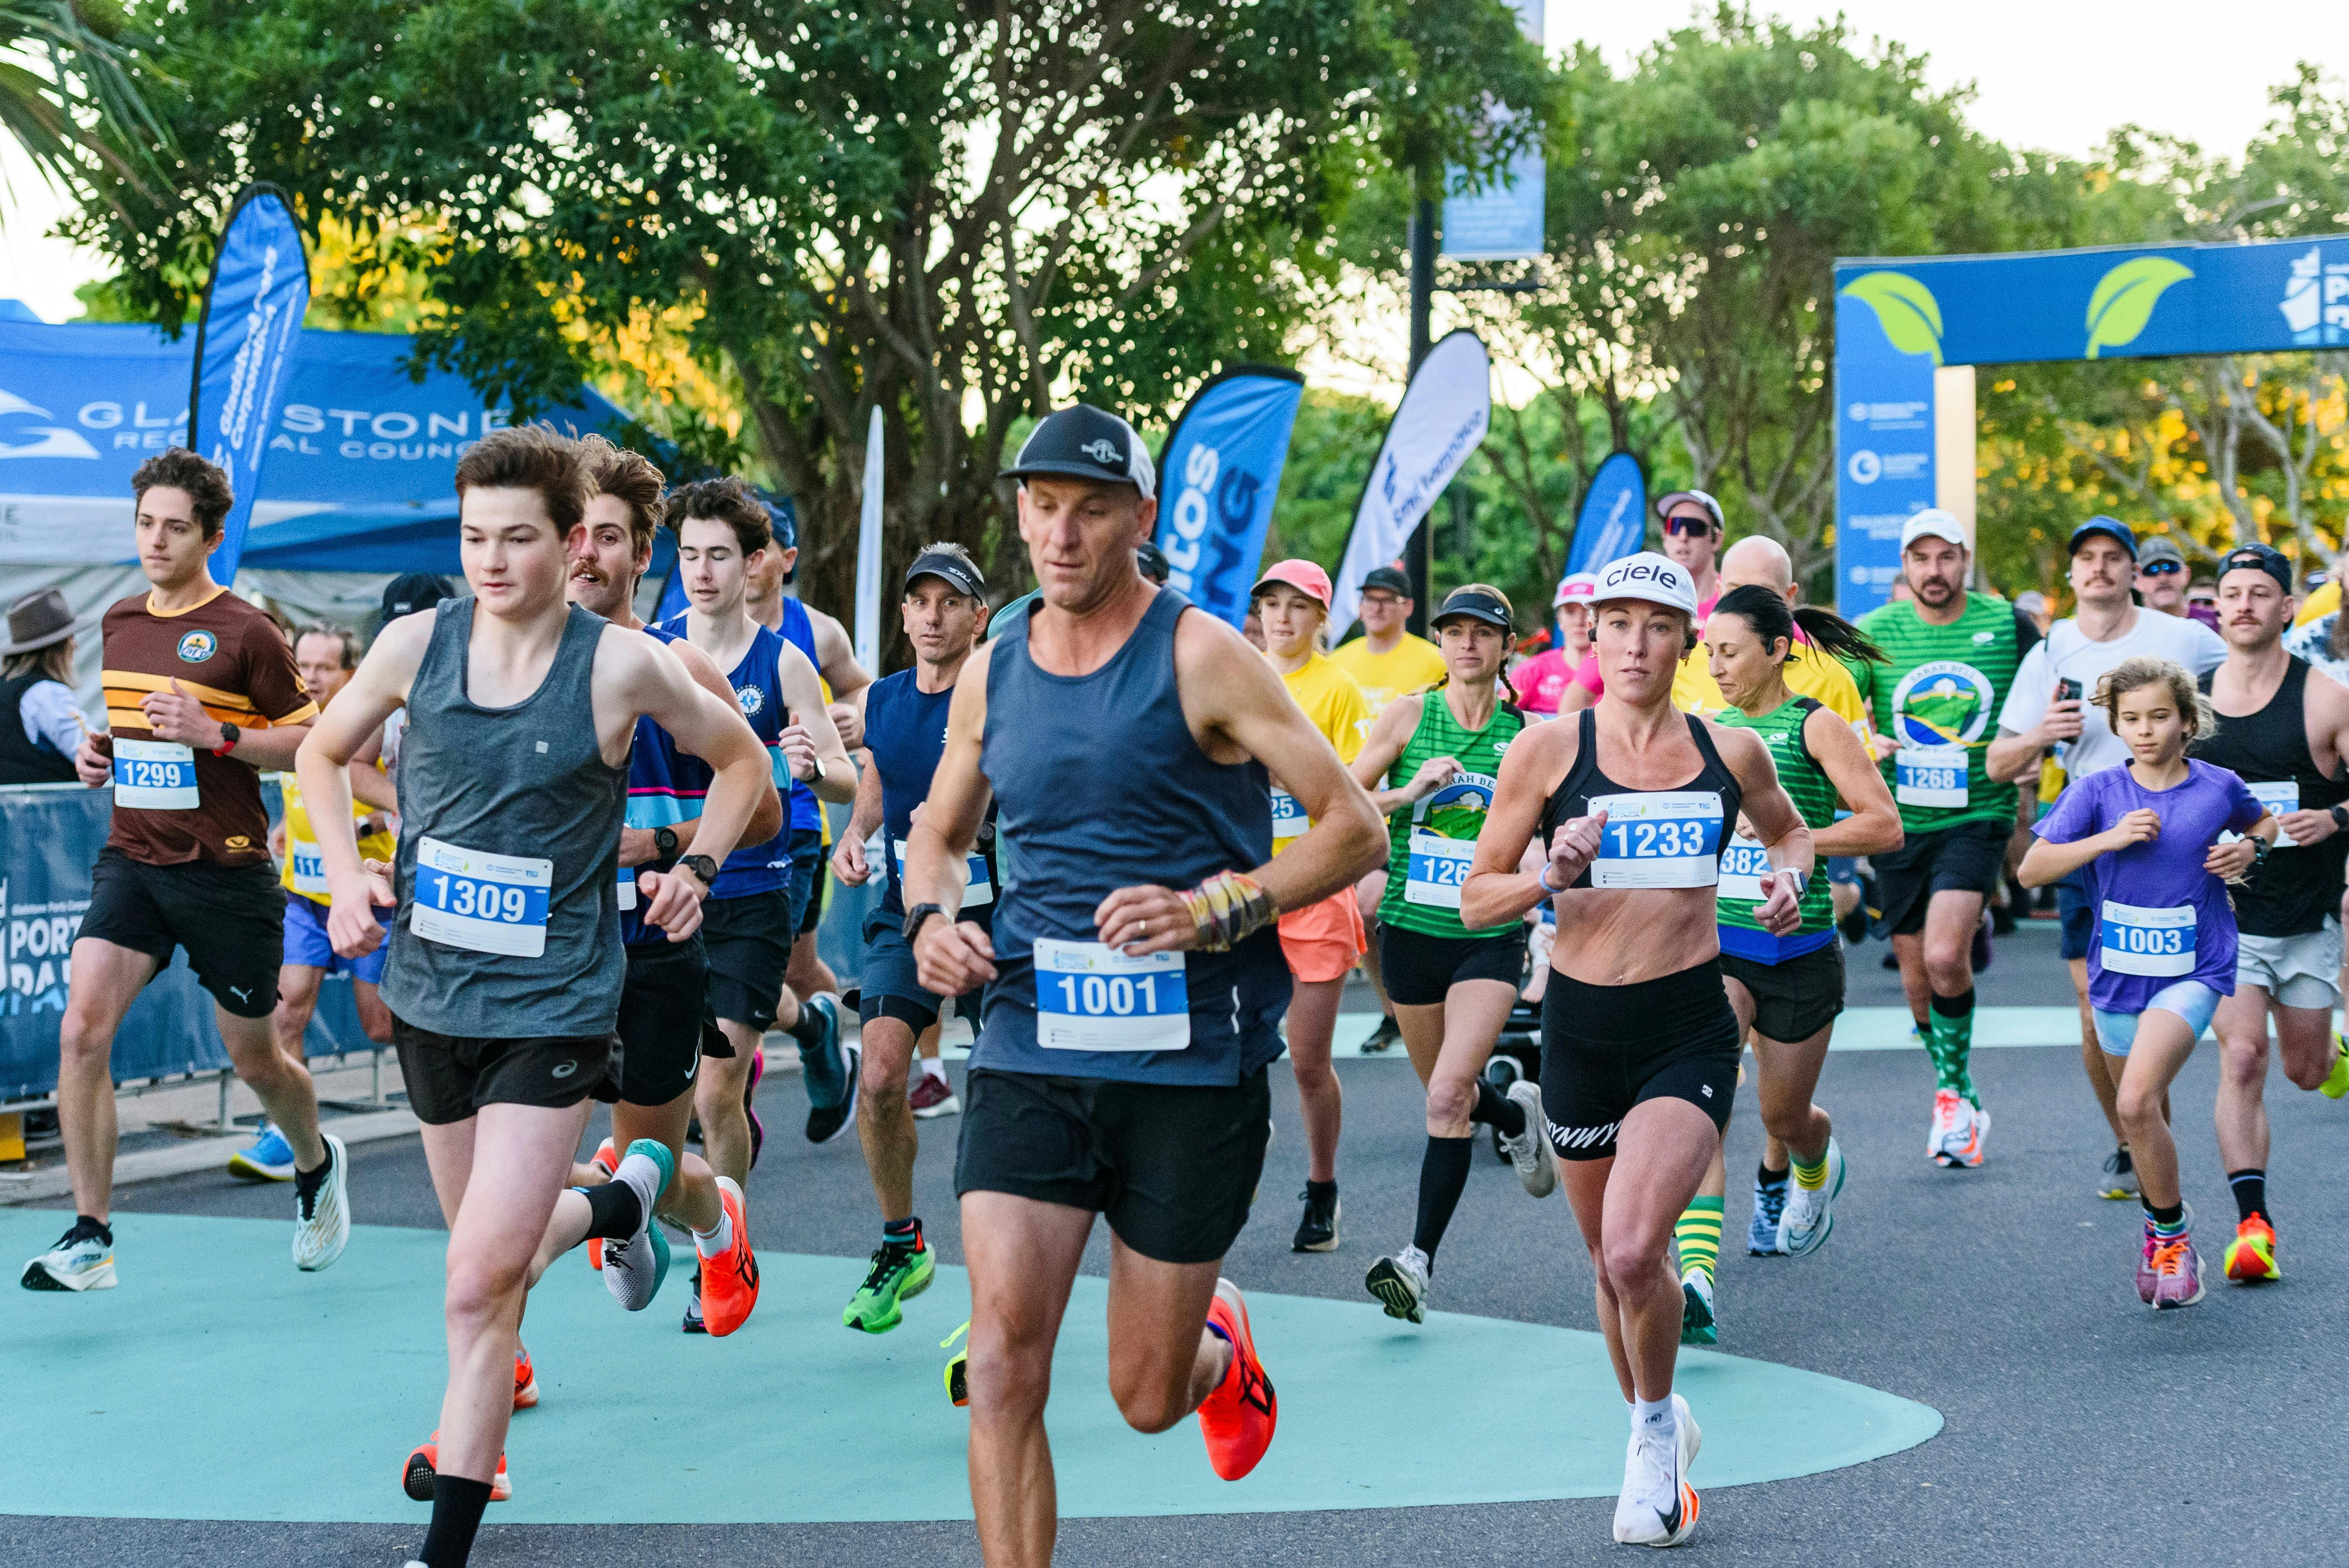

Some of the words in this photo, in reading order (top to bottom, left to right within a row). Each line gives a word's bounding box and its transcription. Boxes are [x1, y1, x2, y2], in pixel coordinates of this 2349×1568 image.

[79, 401, 513, 438] GLSTONE
[1607, 563, 1676, 589] ciele
[124, 761, 181, 787] 1299
[1905, 769, 1956, 789] 1268
[1611, 821, 1704, 857] 1233
[1423, 858, 1471, 885] 126
[1720, 848, 1768, 876] 382
[434, 875, 527, 923] 1309
[2114, 926, 2181, 954] 1003
[1057, 975, 1156, 1015] 1001
